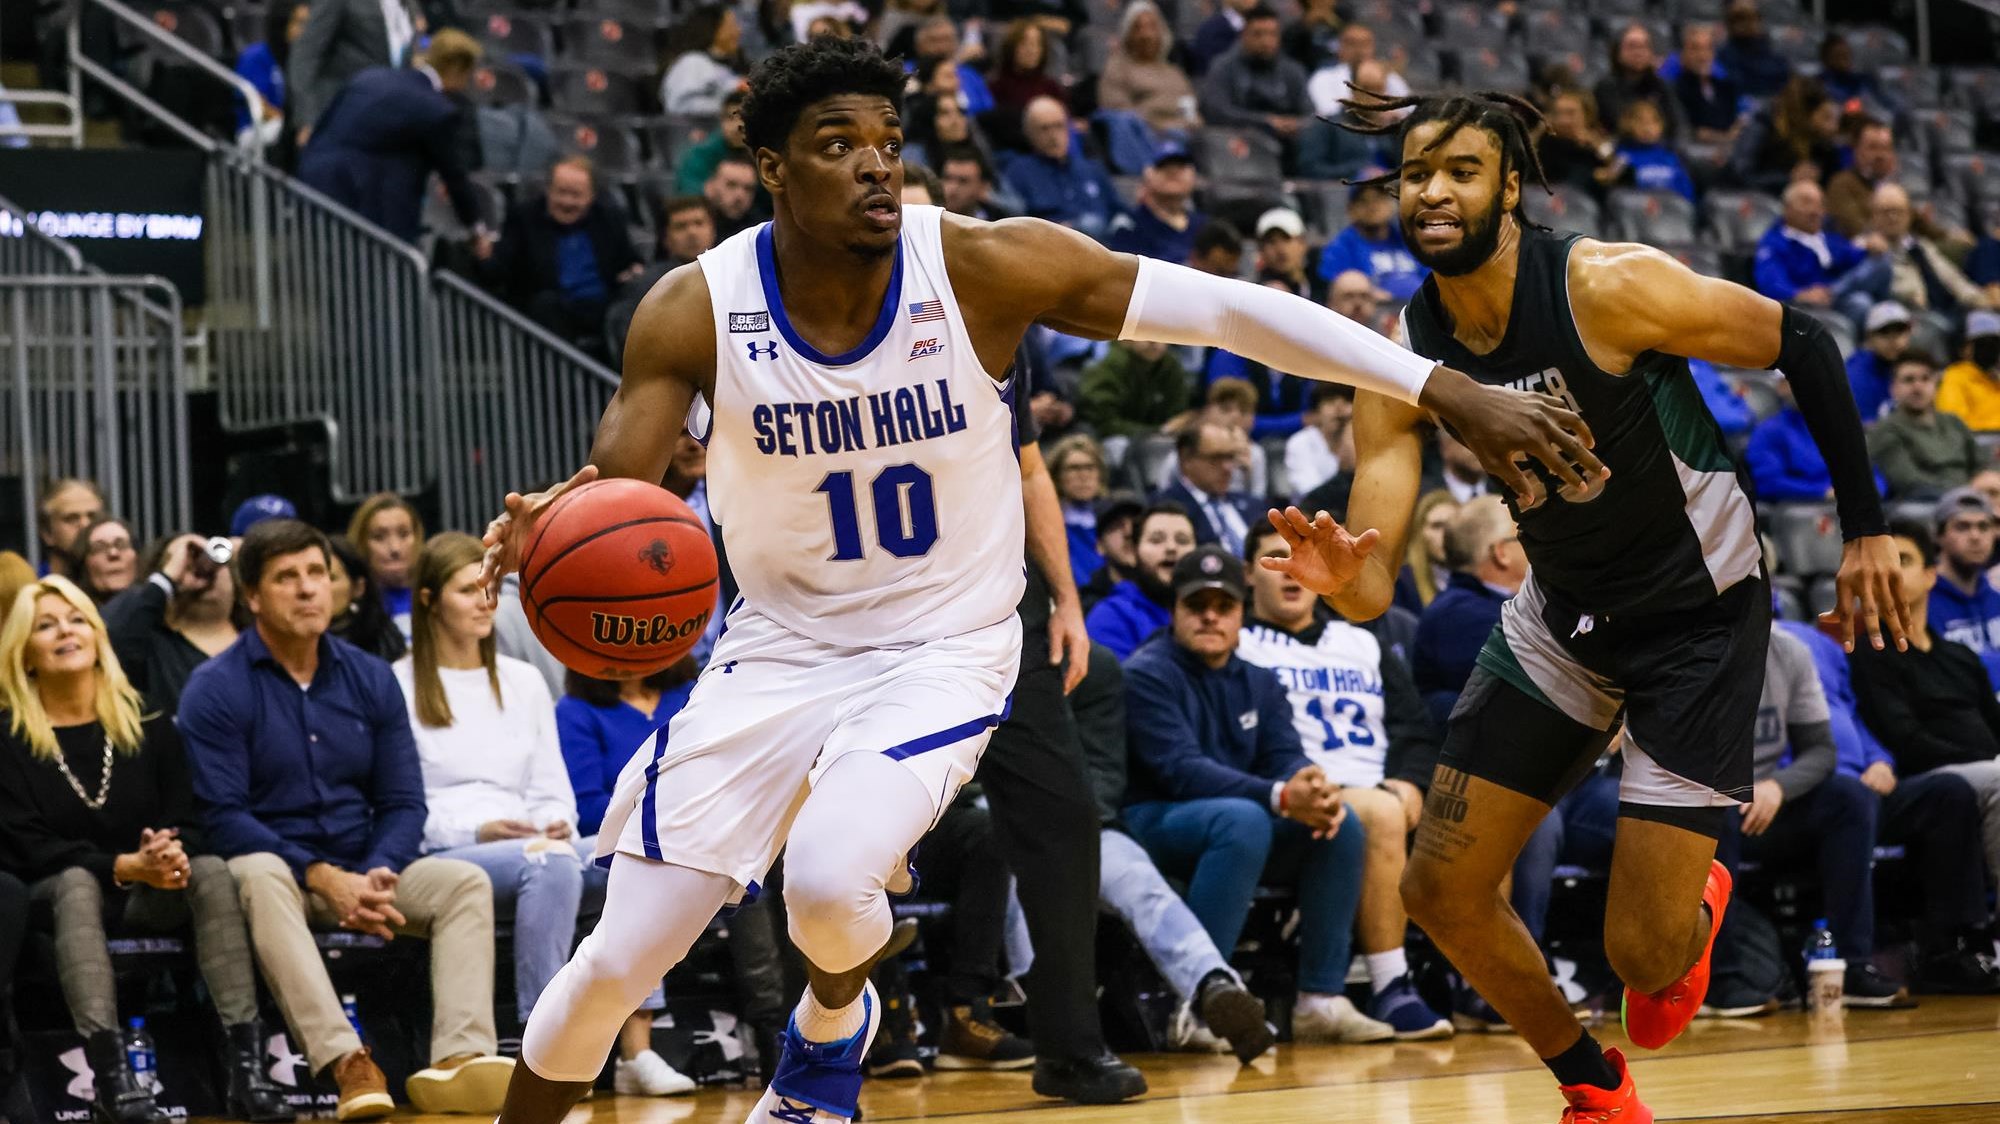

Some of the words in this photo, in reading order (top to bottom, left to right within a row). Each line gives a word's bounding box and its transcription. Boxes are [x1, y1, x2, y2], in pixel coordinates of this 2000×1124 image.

[730, 322, 768, 331] CHANGE
[913, 337, 938, 349] BIG
[910, 344, 945, 357] EAST
[753, 395, 868, 458] SETON
[866, 378, 968, 448] HALL
[811, 460, 940, 562] 10
[590, 607, 710, 648] Wilson
[1306, 697, 1375, 752] 13
